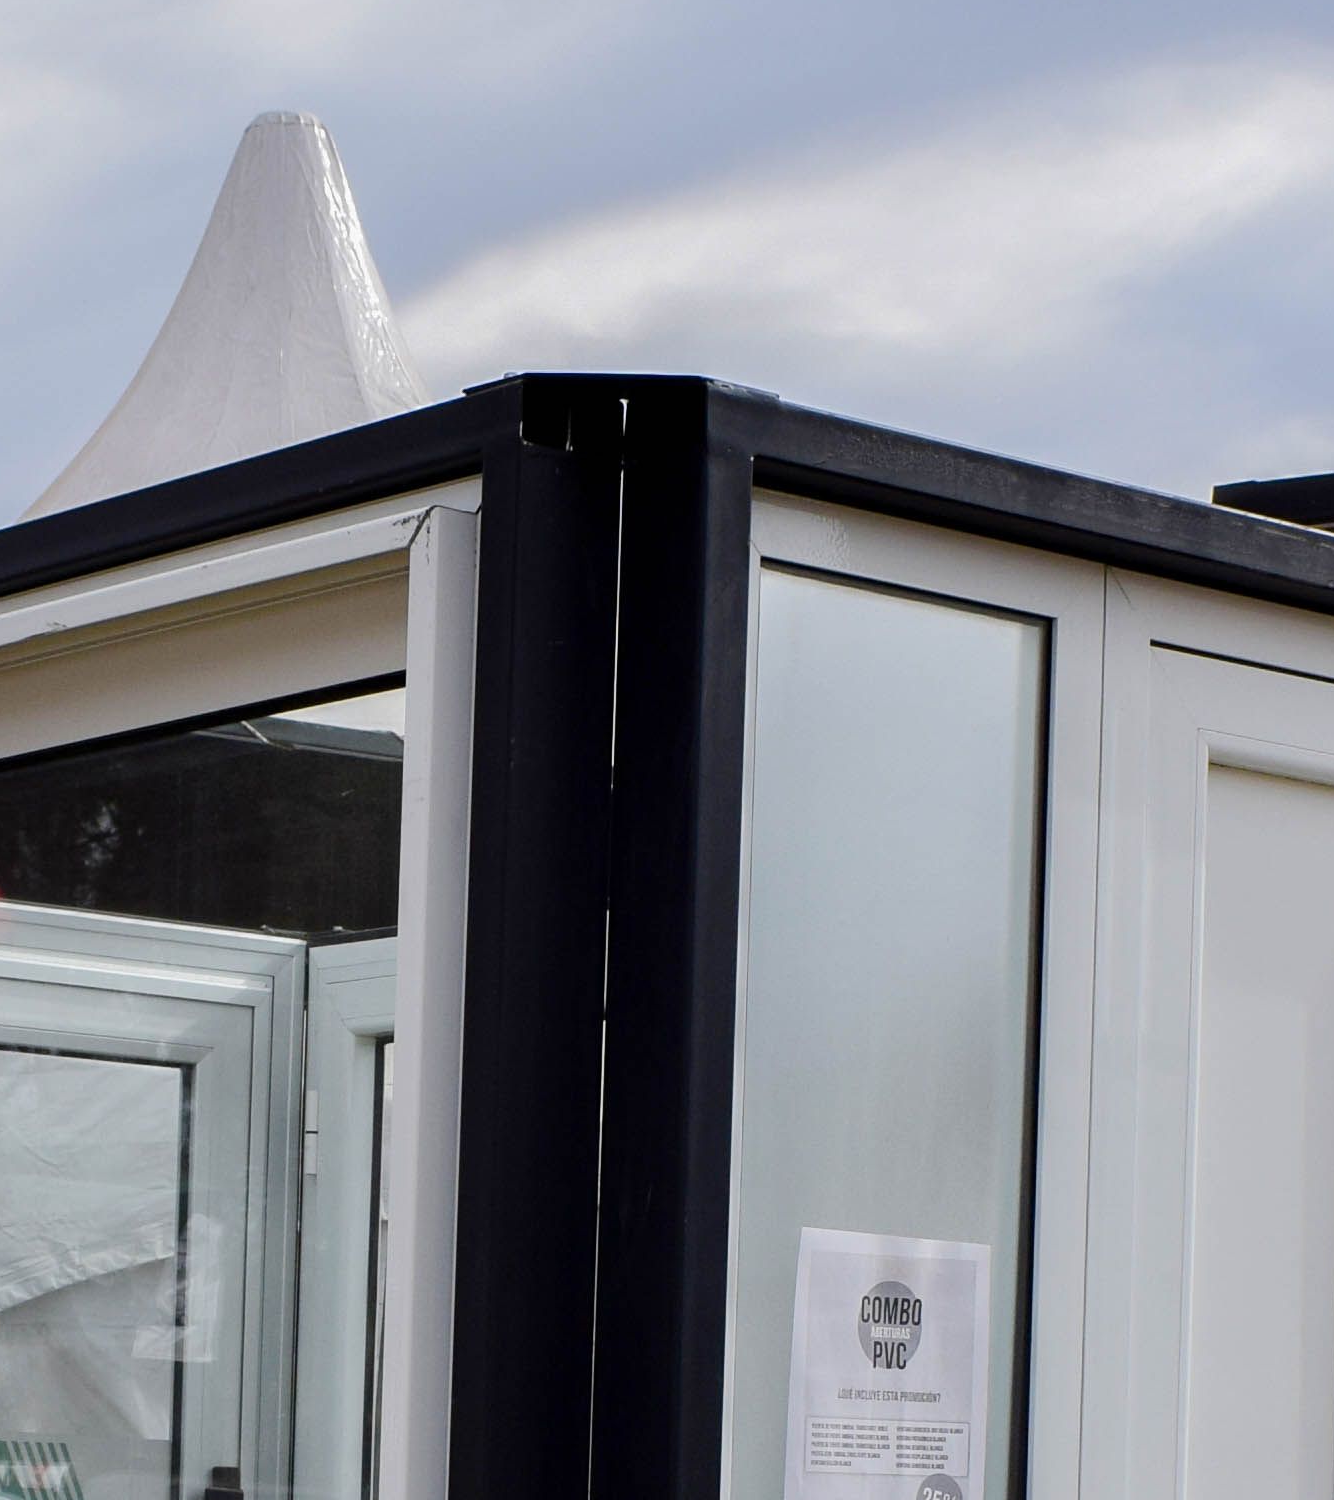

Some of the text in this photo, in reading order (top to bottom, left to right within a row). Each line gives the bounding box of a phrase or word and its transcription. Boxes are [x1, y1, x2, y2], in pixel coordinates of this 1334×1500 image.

[861, 1295, 922, 1326] COMBO
[873, 1341, 906, 1370] PVC
[883, 1390, 898, 1402] ESTA
